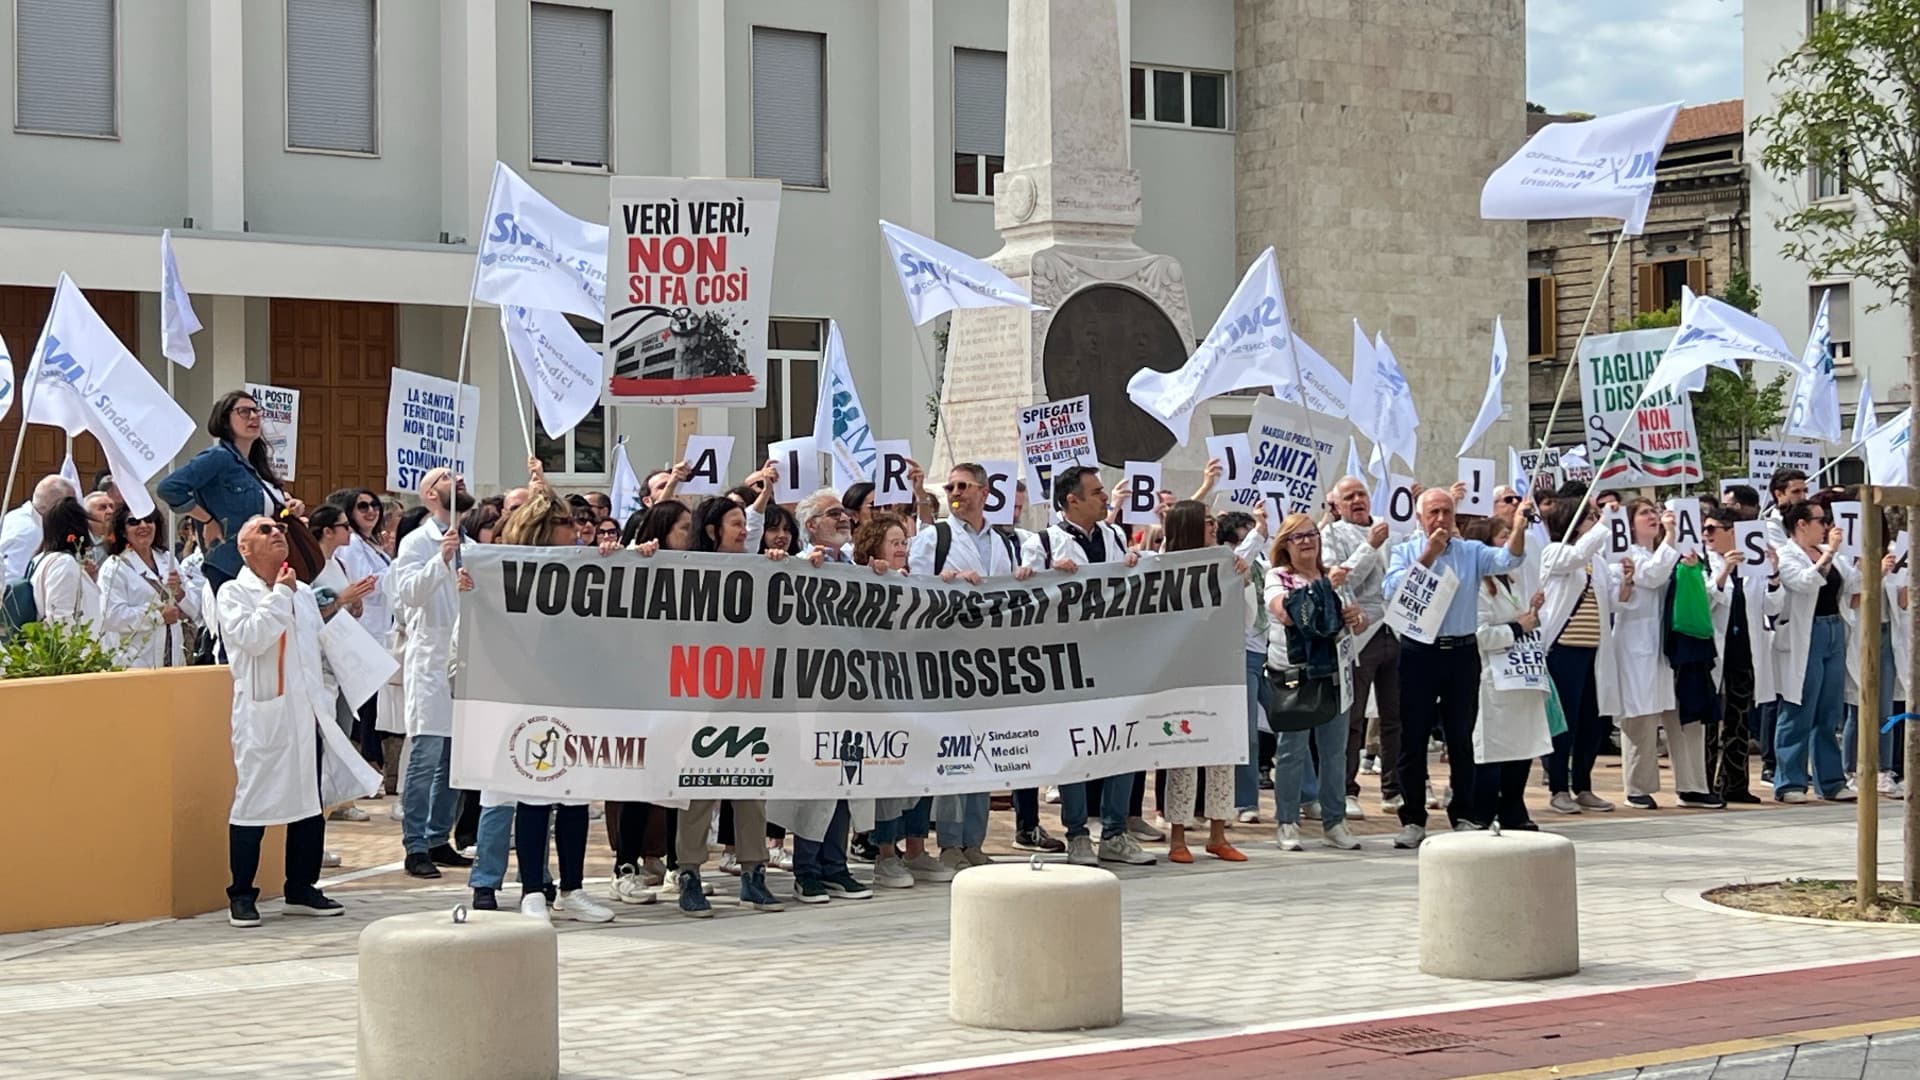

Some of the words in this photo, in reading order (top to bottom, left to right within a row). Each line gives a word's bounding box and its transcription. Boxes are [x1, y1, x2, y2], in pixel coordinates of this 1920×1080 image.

[623, 198, 679, 235] VERÌ
[688, 197, 750, 237] VERÌ,
[628, 236, 727, 274] NON
[629, 275, 651, 304] SI
[660, 276, 688, 305] FA
[695, 267, 748, 305] COSÌ
[1589, 350, 1667, 386] TAGLIAT
[265, 390, 293, 404] POSTO
[408, 388, 419, 403] LA
[422, 391, 454, 411] SANITÀ
[1023, 400, 1084, 424] SPIEGATE
[1593, 389, 1599, 413] I
[95, 395, 156, 461] Sindacato
[402, 403, 465, 429] TERRITORIAE
[403, 419, 425, 435] NON
[427, 424, 434, 437] SI
[1039, 420, 1046, 431] A
[1050, 414, 1071, 427] CHI
[1052, 422, 1086, 436] VOTATO
[1637, 408, 1671, 431] NON
[420, 437, 439, 453] CON
[1028, 454, 1042, 465] NON
[1044, 453, 1051, 462] CI
[1073, 446, 1090, 458] DATO
[1060, 436, 1088, 450] BILANCI
[1292, 433, 1334, 455] PRESENTE
[1640, 434, 1645, 452] I
[1754, 448, 1786, 457] SEMPE
[685, 448, 718, 484] A
[789, 450, 799, 489] I
[882, 453, 907, 493] R
[1225, 446, 1237, 480] I
[983, 475, 1008, 513] S
[1132, 475, 1155, 512] B
[1472, 470, 1480, 504] !
[1266, 492, 1285, 524] T
[1390, 486, 1413, 522] O
[1611, 518, 1628, 553] B
[1677, 510, 1699, 544] A
[1841, 513, 1858, 545] T
[1745, 532, 1765, 566] S
[502, 560, 754, 624] VOGLIAMO
[767, 572, 903, 630] CURARE
[900, 587, 921, 630] I
[915, 587, 1049, 630] NOSTRI
[1057, 563, 1222, 623] PAZIENTI
[670, 645, 765, 699] NON
[772, 648, 787, 699] I
[797, 648, 913, 700] VOSTRI
[916, 642, 1094, 699] DISSESTI.
[564, 734, 648, 769] SNAMI
[937, 736, 971, 757] SMI
[989, 729, 1039, 741] Sindacato
[991, 744, 1028, 757] Medici
[682, 776, 713, 786] CISL
[720, 776, 770, 786] MEDICI
[994, 761, 1031, 773] Italiani
